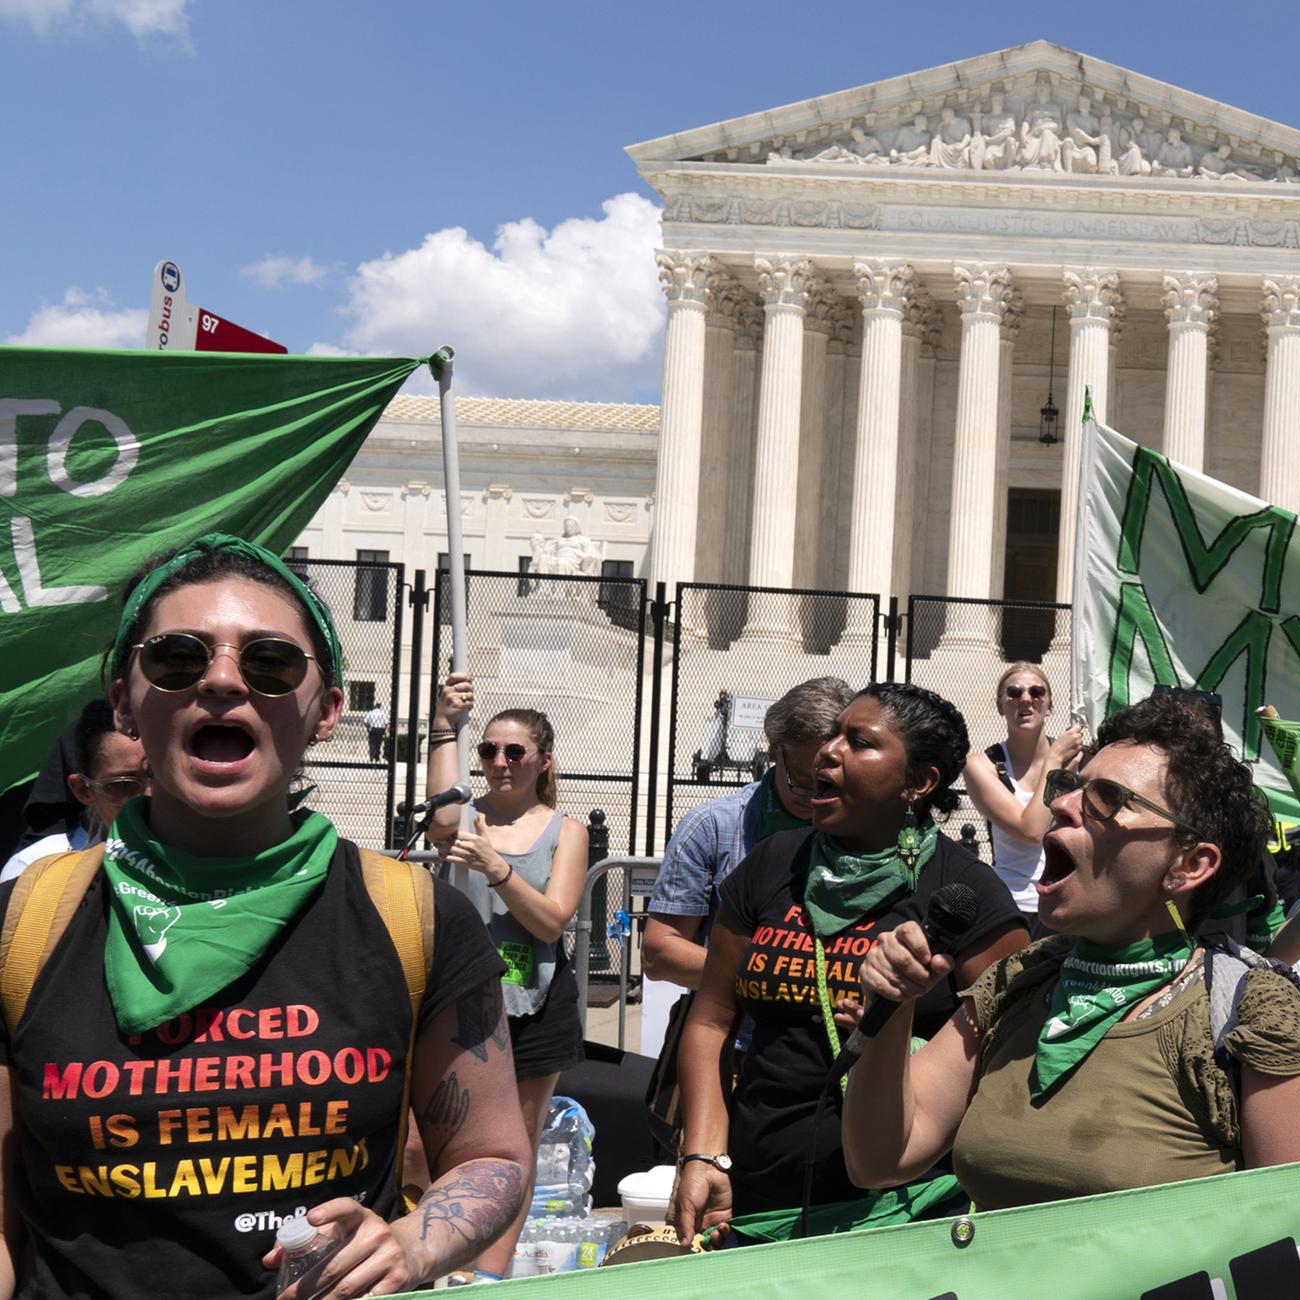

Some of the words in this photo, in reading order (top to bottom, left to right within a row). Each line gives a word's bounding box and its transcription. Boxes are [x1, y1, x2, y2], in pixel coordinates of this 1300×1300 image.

[972, 214, 1054, 233] JUSTICE
[1062, 217, 1130, 236] UNDER
[1139, 221, 1178, 238] LAW
[158, 295, 173, 350] robus
[202, 314, 219, 334] 97
[0, 399, 140, 498] TO
[746, 952, 768, 972] IS
[773, 955, 862, 984] FEMAL
[127, 1004, 320, 1046] ORCED
[42, 1047, 392, 1100] MOTHERHOOD
[88, 1113, 139, 1150] IS
[157, 1100, 350, 1145] FEMALE
